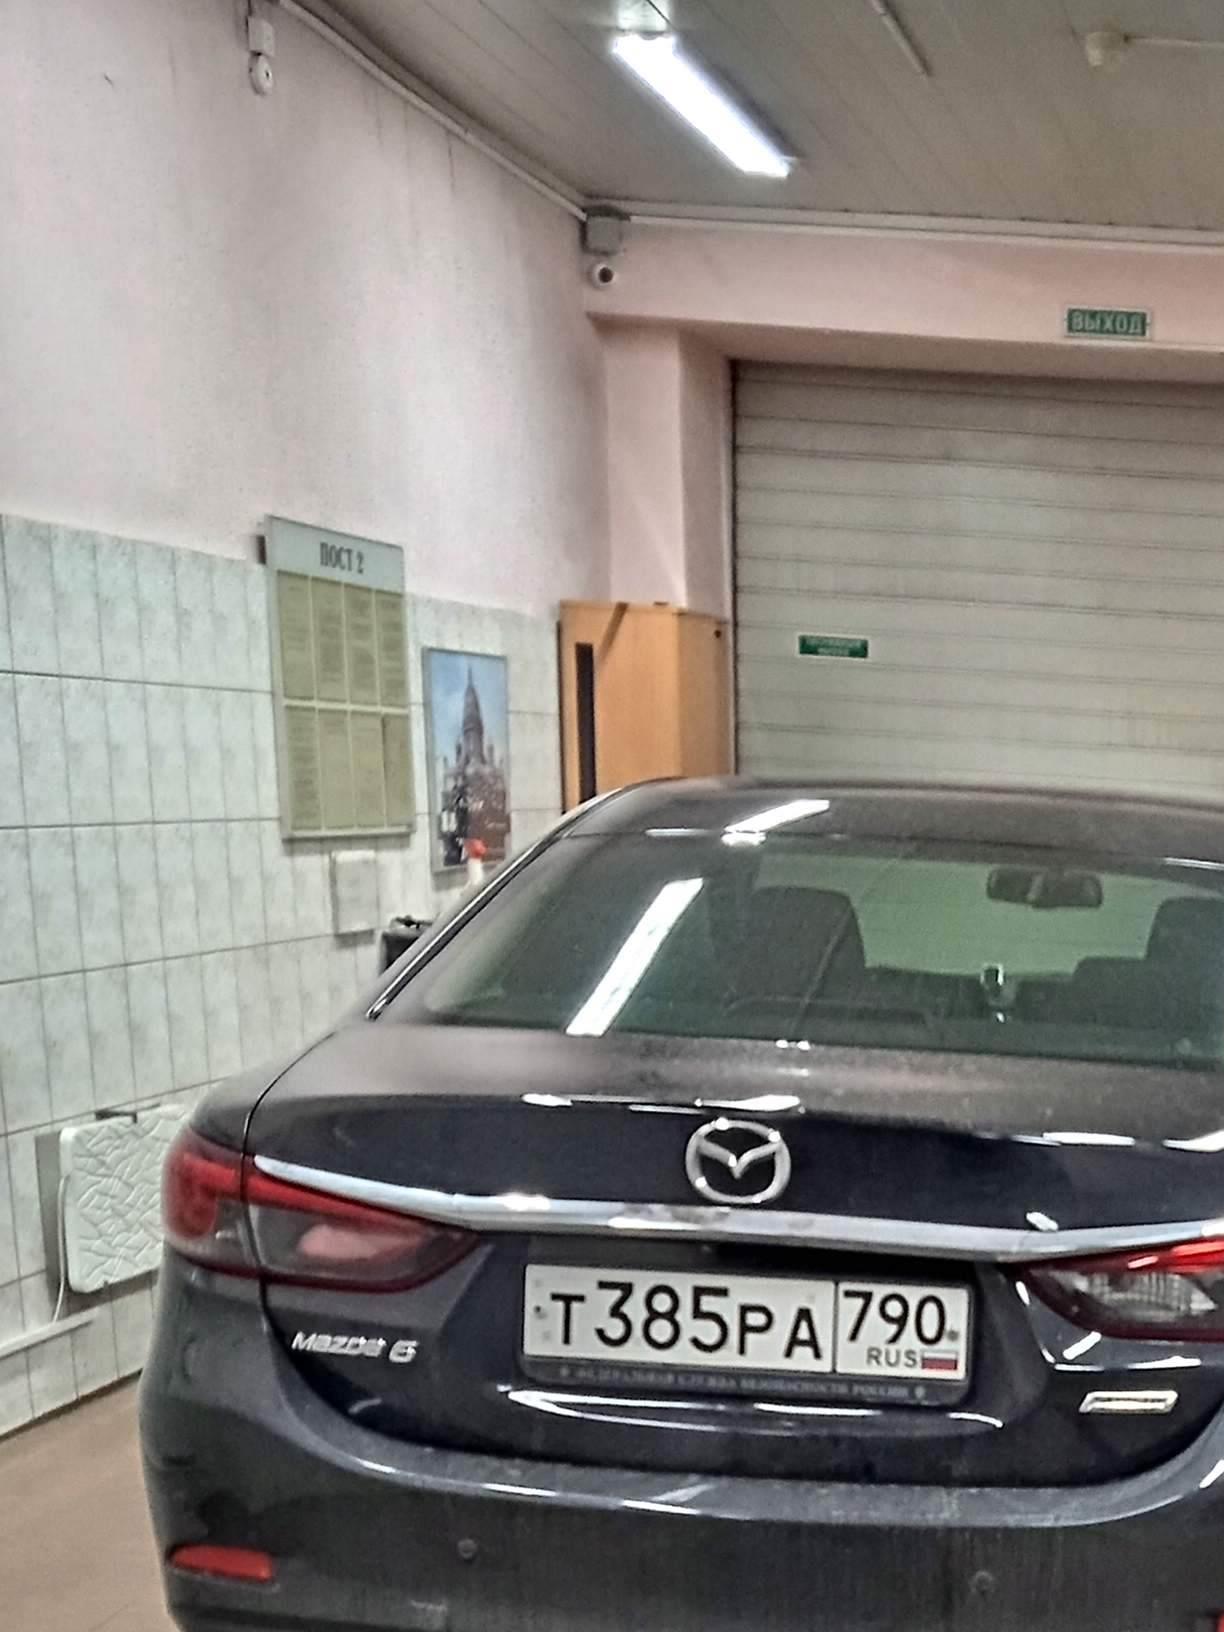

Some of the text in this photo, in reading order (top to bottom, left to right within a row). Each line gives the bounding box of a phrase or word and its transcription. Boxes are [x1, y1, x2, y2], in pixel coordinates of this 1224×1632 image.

[1072, 310, 1142, 334] ВЫХОД
[320, 542, 364, 574] ПОСТ 2
[844, 1289, 947, 1346] 790
[388, 1339, 420, 1364] 6
[866, 1347, 918, 1369] RUS
